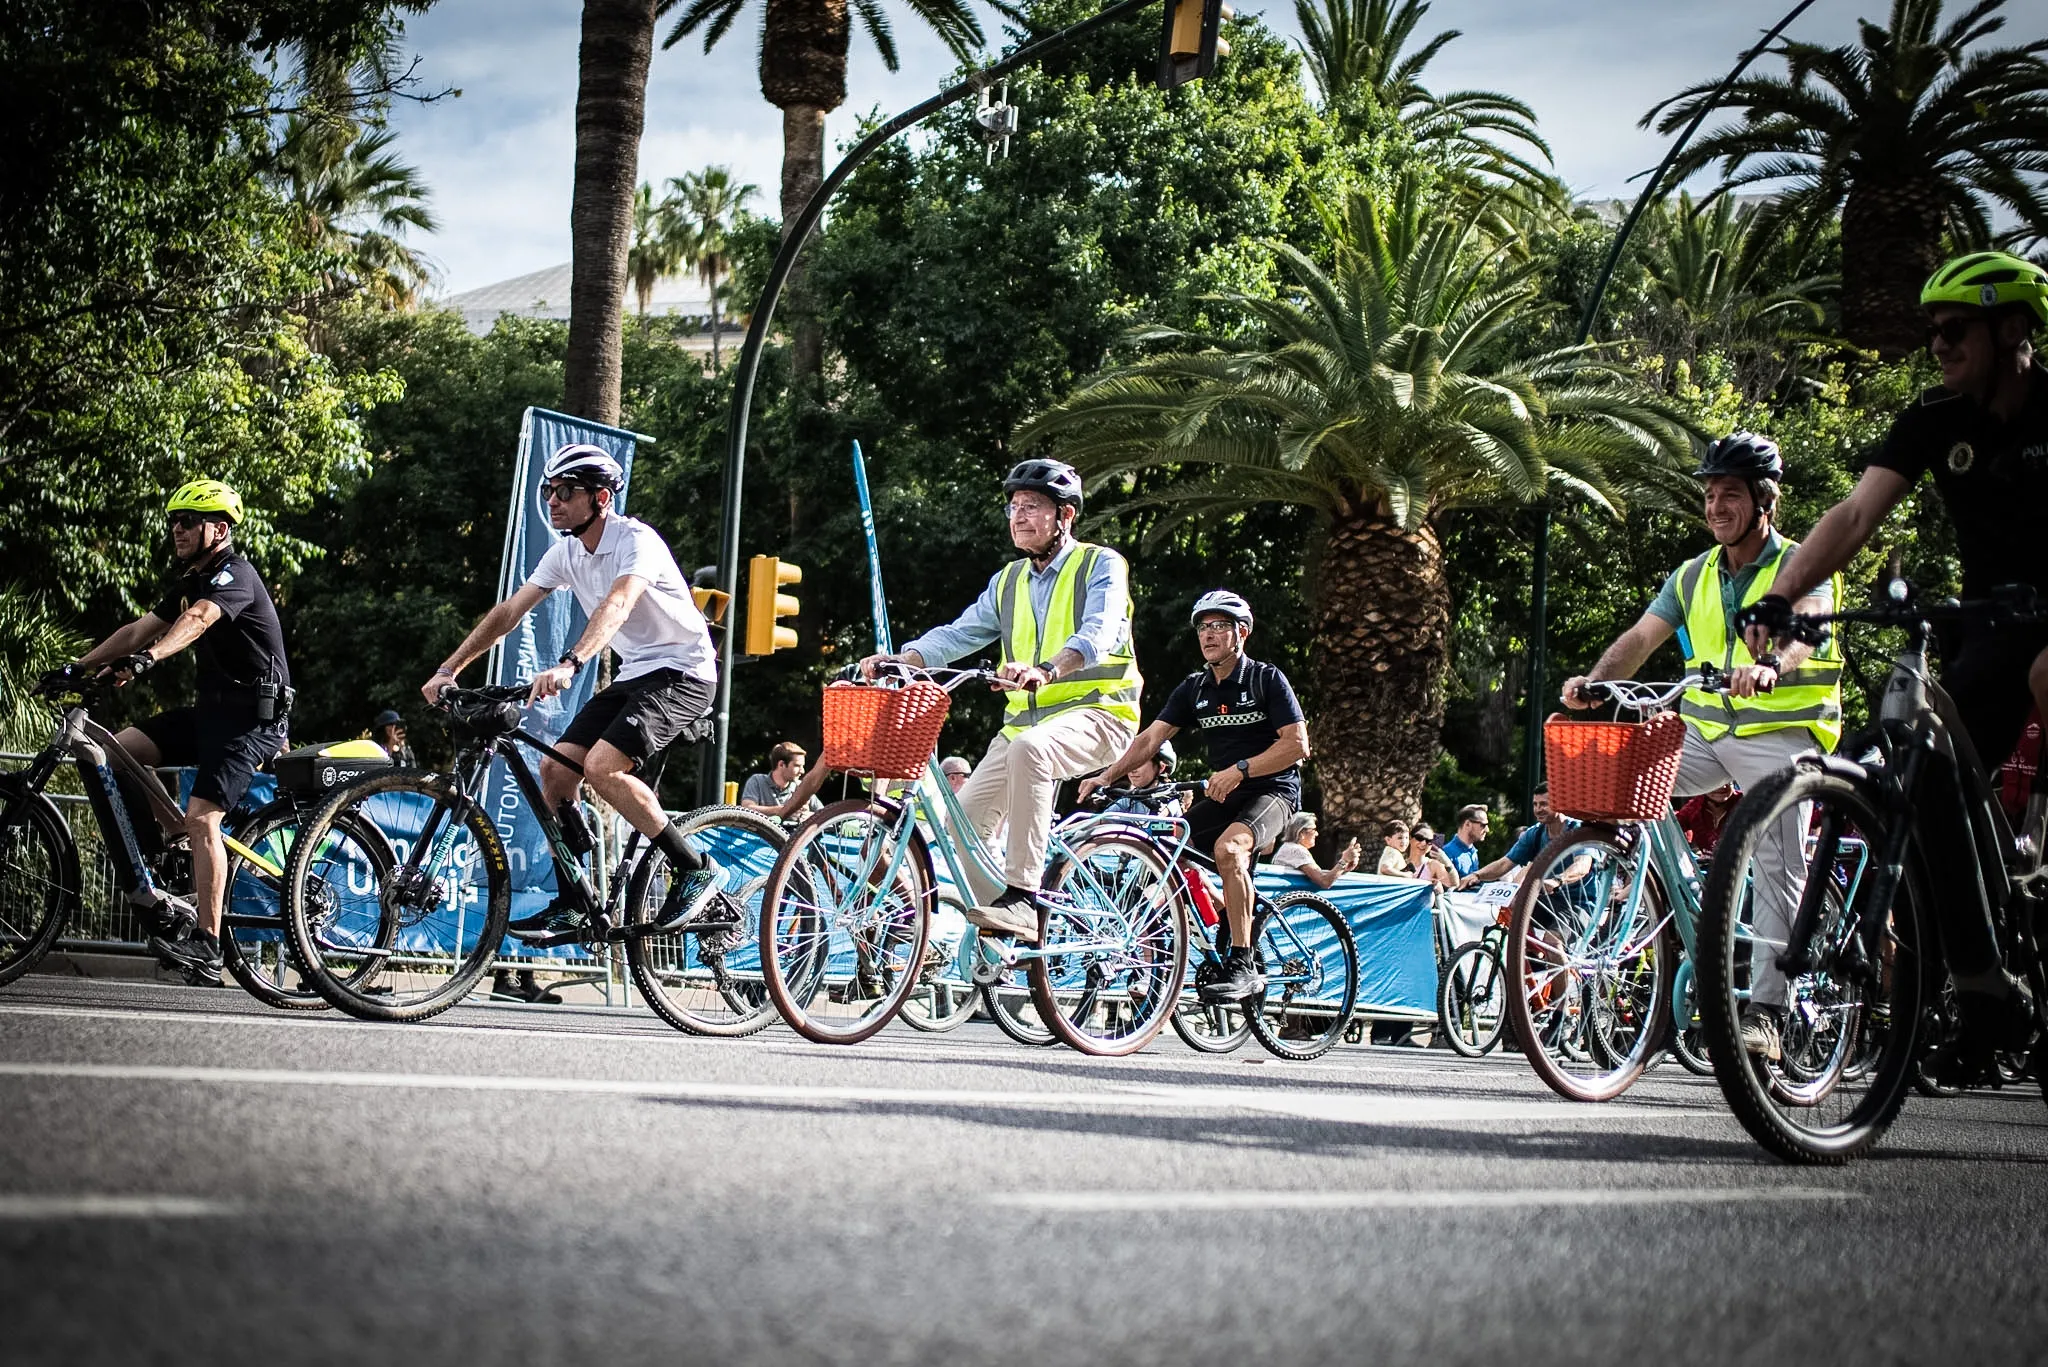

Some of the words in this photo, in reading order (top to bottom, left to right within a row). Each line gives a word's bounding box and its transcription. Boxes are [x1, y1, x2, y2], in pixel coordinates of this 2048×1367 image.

[434, 823, 460, 863] ROCKSHOX
[475, 816, 504, 871] MAXXIS
[1488, 888, 1512, 897] 590
